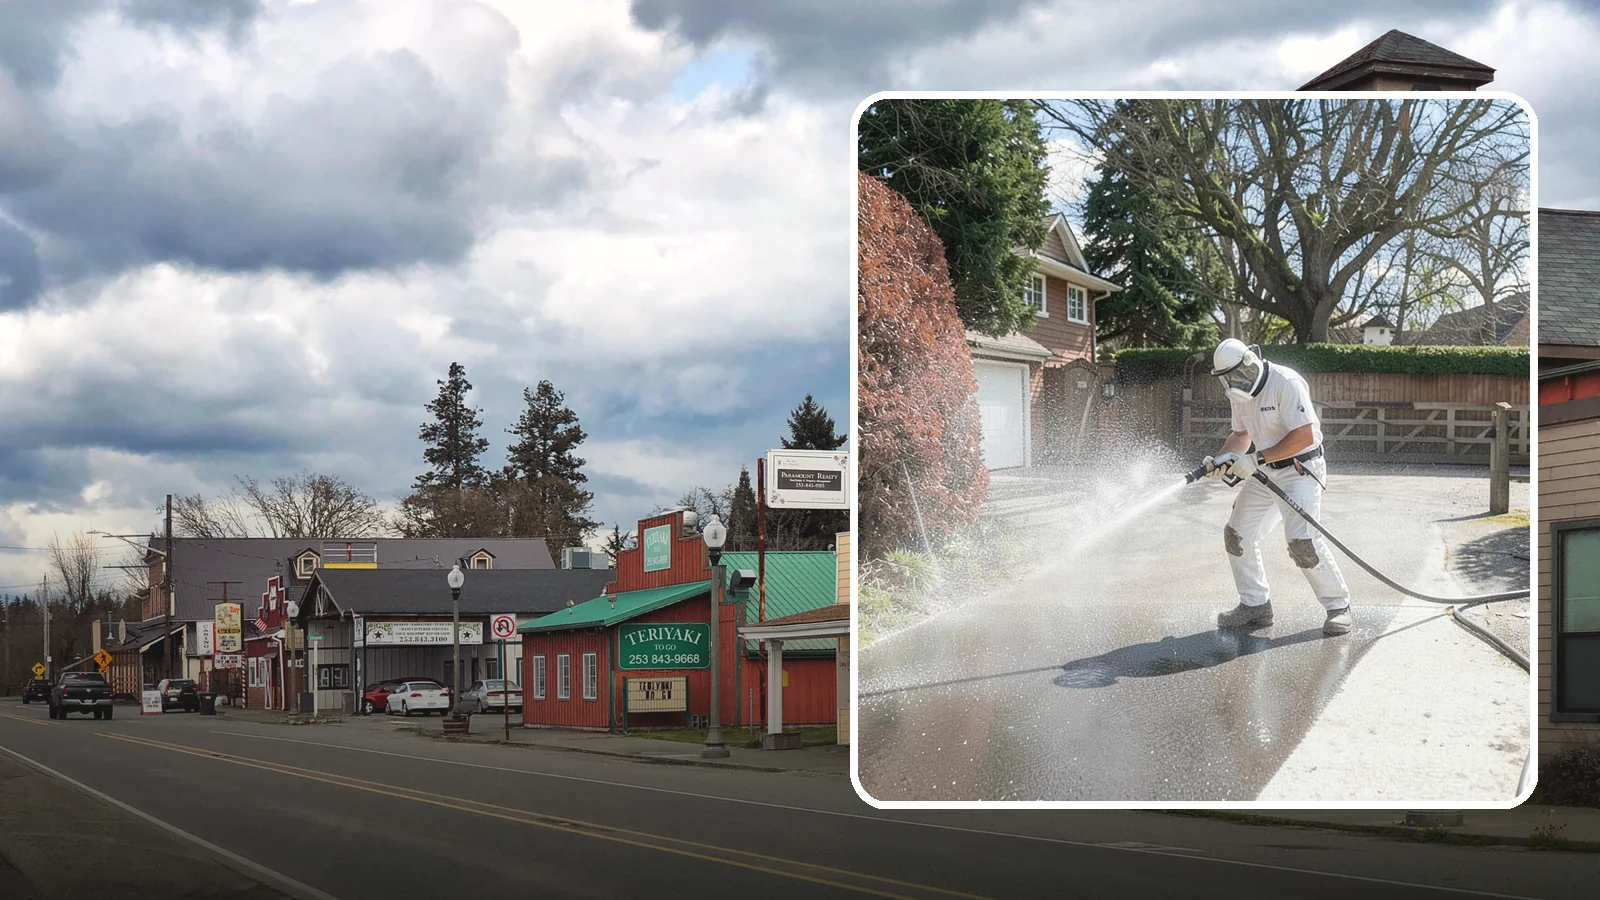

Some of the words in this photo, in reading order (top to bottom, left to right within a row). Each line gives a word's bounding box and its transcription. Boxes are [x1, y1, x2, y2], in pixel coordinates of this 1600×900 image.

[781, 471, 815, 479] PARAMOUNT
[625, 627, 702, 646] TERIYAKI
[629, 654, 649, 664] 253
[651, 654, 700, 664] 843-9668
[640, 681, 672, 690] TERIYAKI
